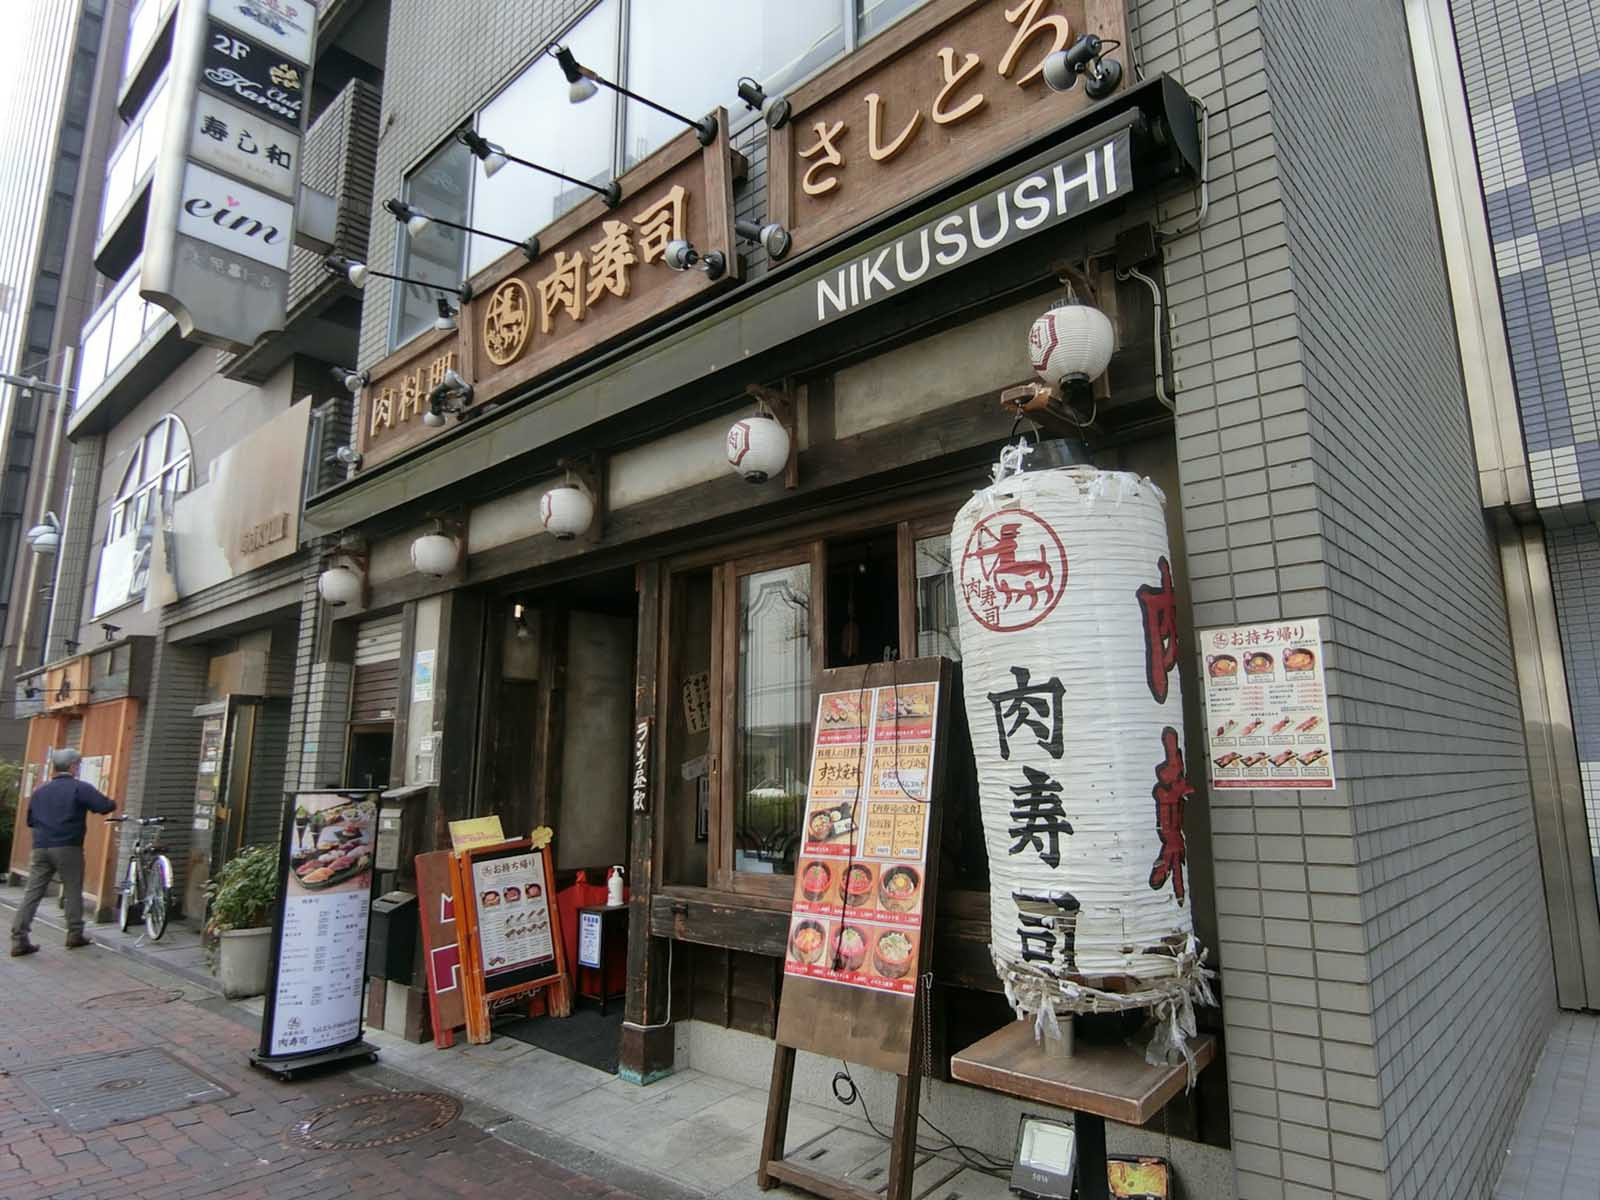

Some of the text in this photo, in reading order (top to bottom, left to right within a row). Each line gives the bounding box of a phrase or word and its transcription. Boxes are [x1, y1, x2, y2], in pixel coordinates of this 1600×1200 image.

[213, 34, 251, 60] 2F
[203, 66, 298, 119] Karen
[814, 141, 1120, 321] NIKUSUSHI
[536, 184, 692, 335] 肉寿司
[1231, 625, 1304, 647] お持ち帰り
[987, 665, 1080, 980] 肉寿司
[493, 857, 536, 874] お持ち帰り
